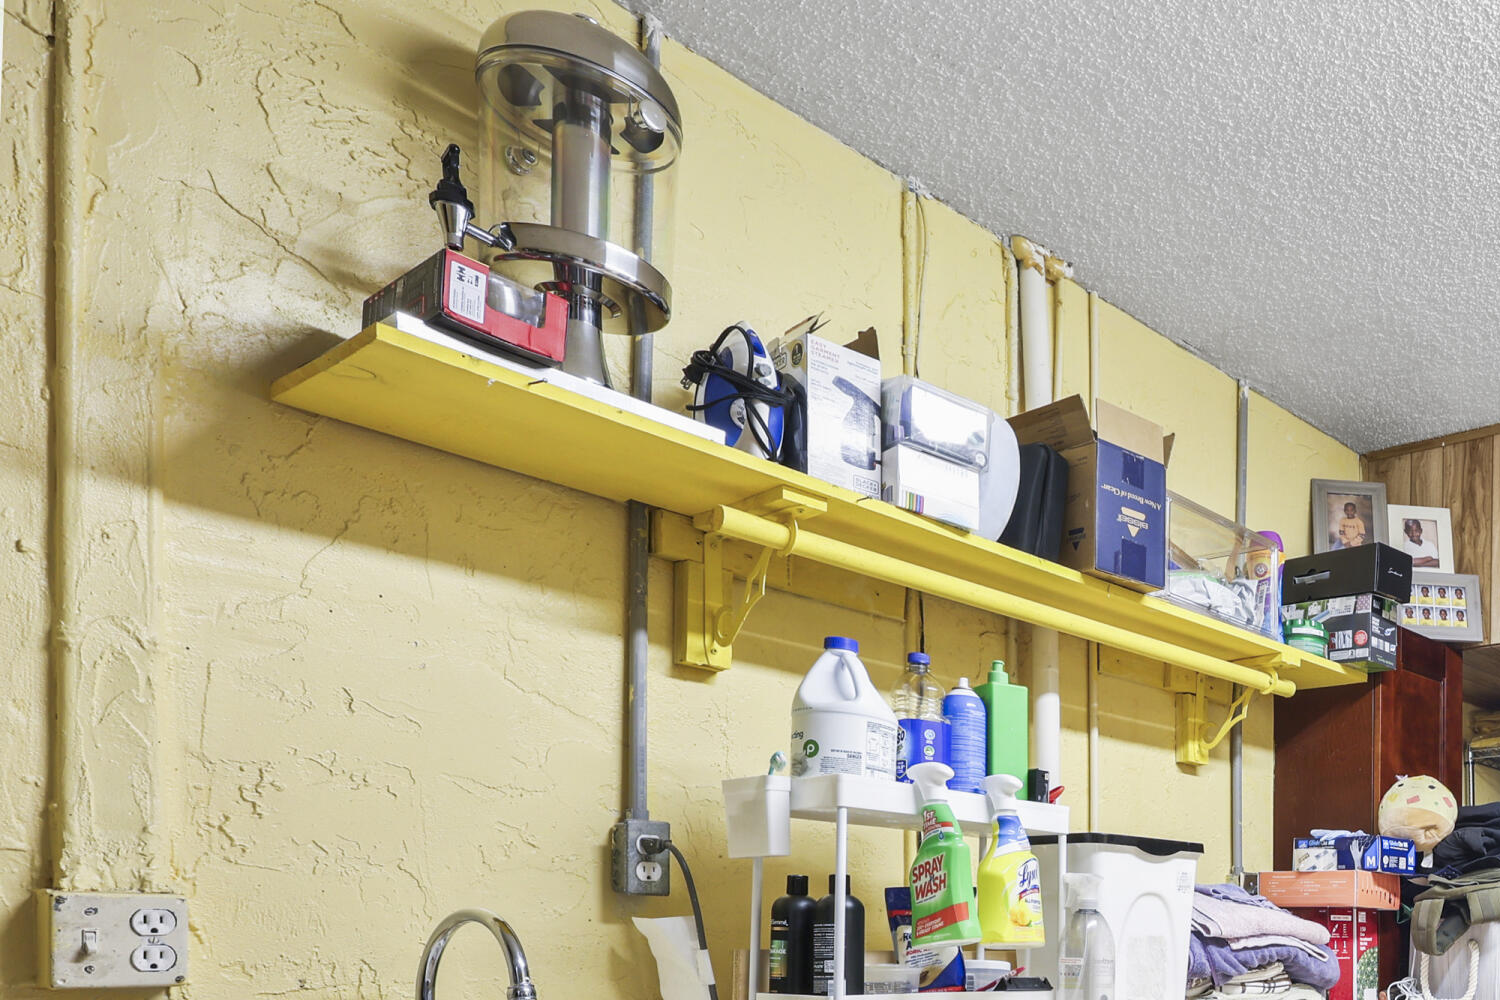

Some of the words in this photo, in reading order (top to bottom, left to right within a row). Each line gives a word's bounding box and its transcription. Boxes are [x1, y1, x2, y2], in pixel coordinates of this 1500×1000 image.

[912, 854, 945, 884] SPRAY
[1366, 856, 1376, 867] M
[914, 872, 947, 901] WASH
